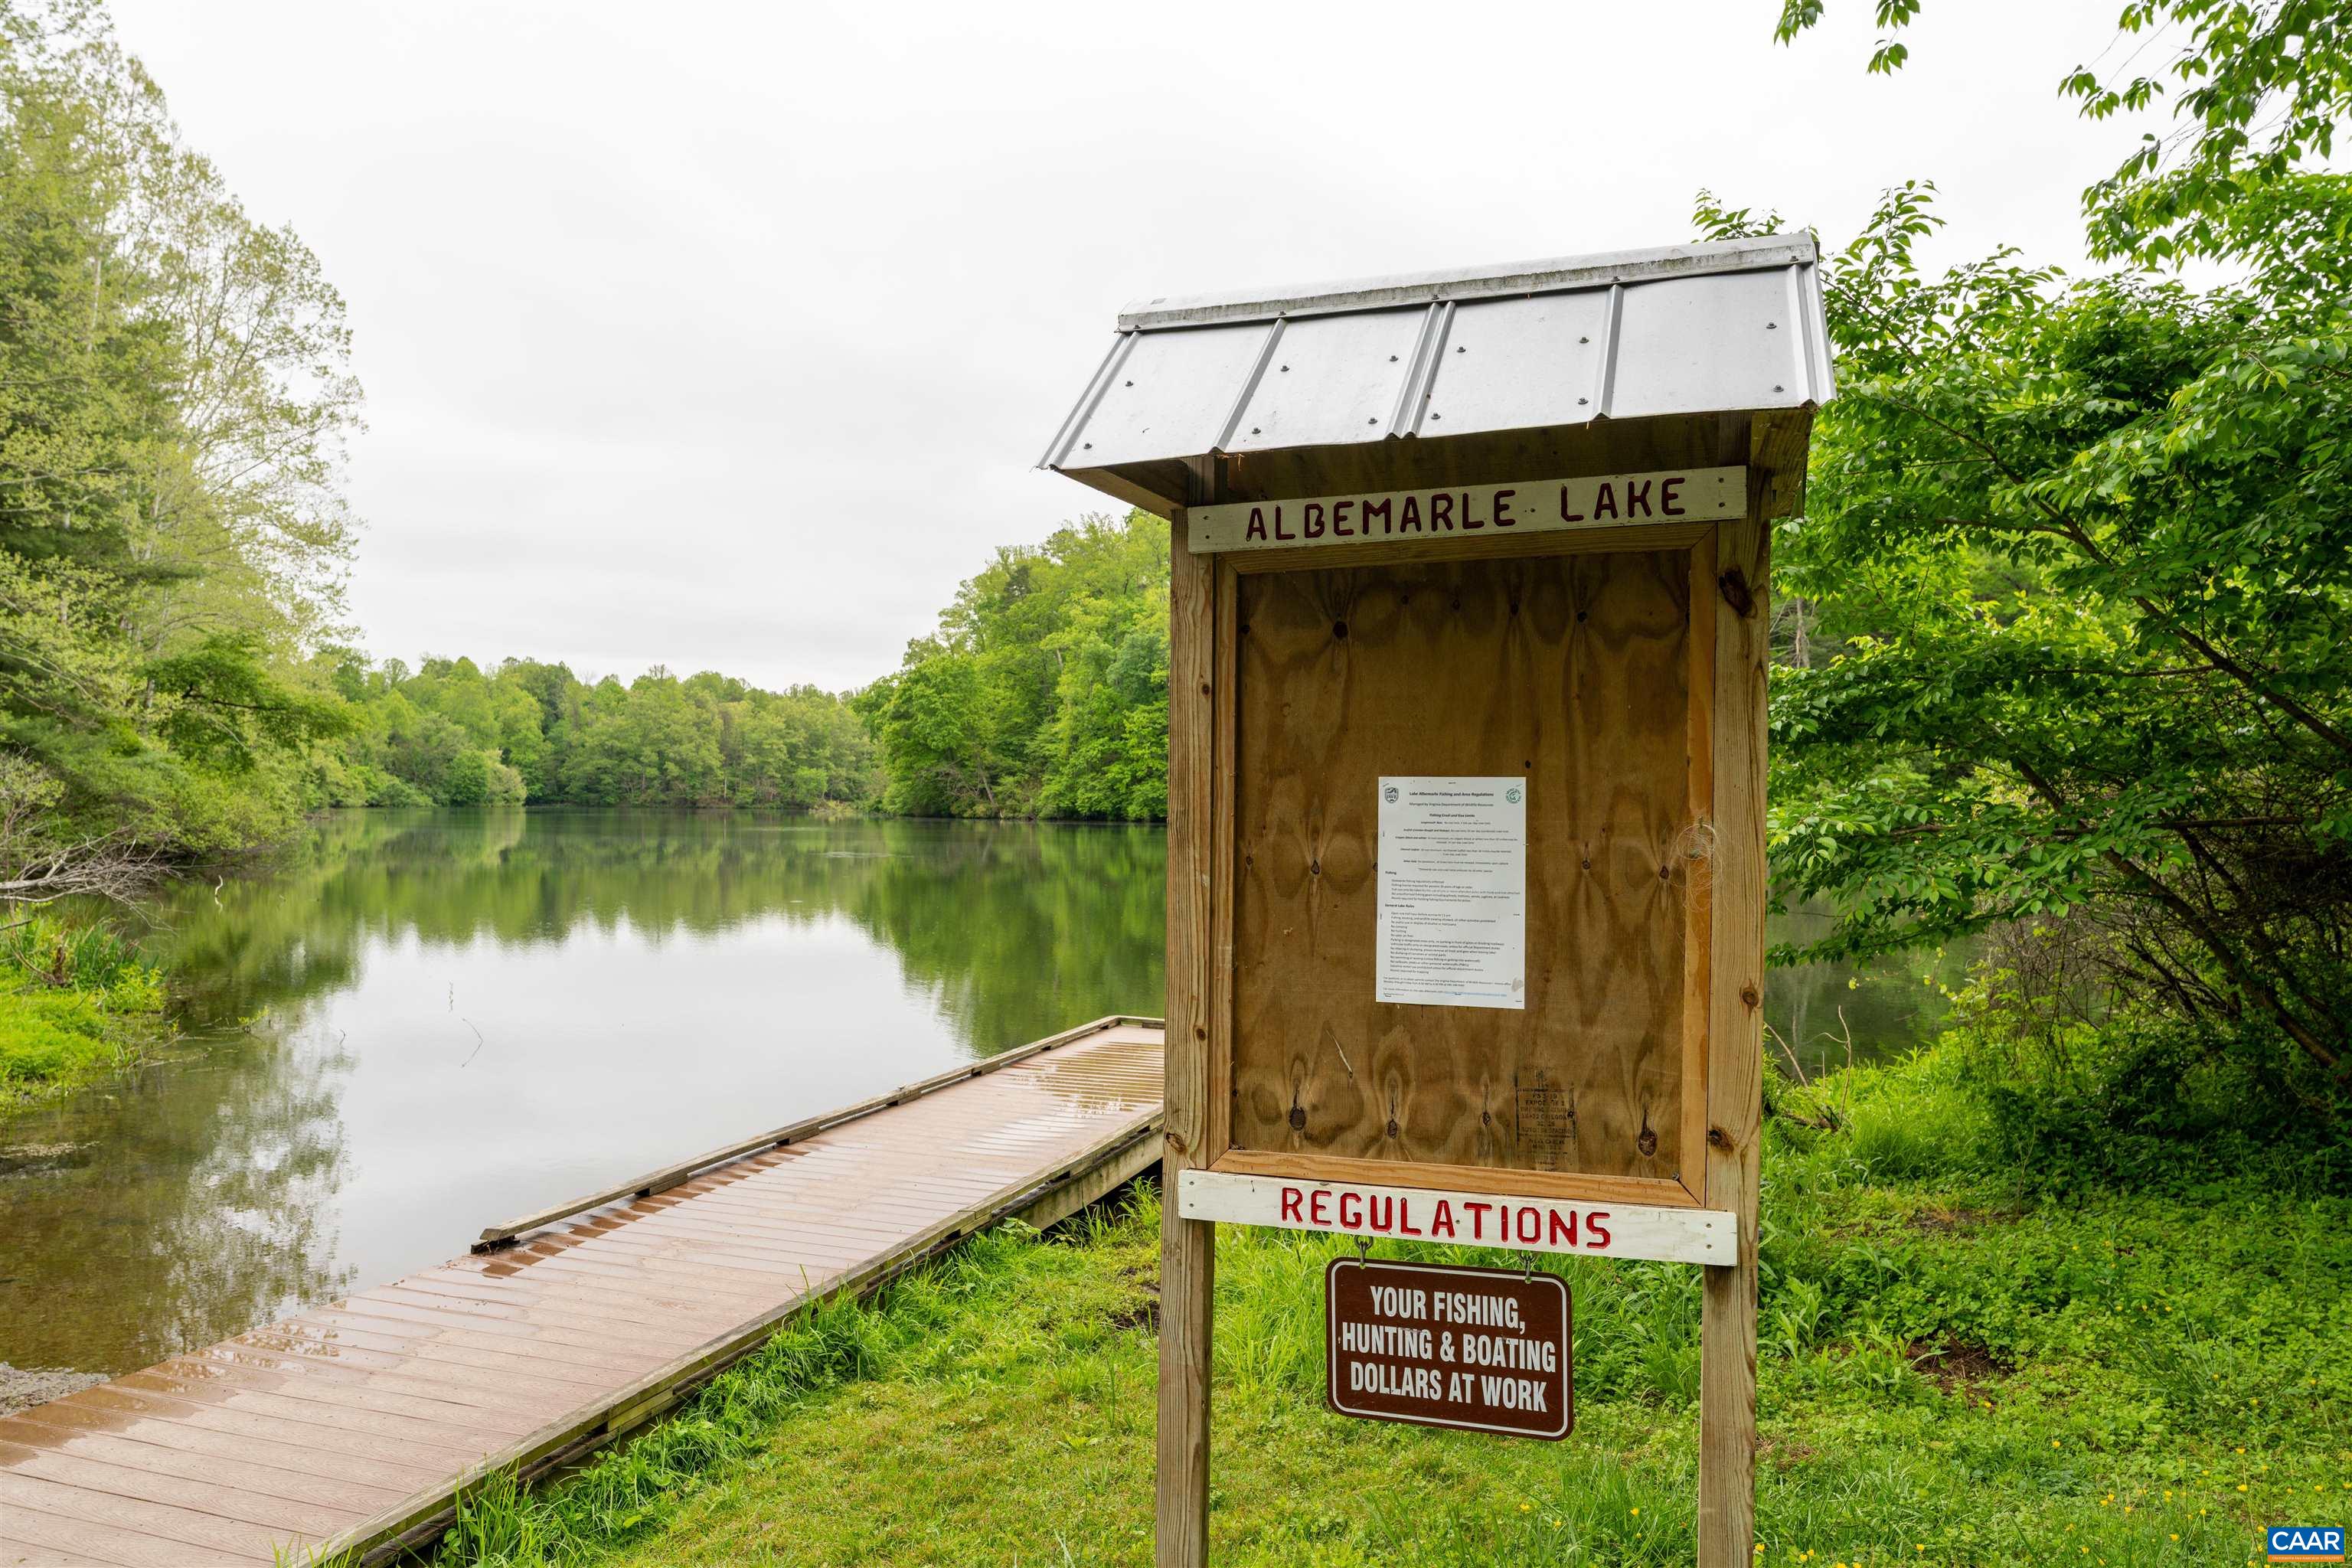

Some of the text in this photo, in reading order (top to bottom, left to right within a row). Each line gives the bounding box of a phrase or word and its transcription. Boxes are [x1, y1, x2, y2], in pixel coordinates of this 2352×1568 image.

[1246, 477, 1685, 541] ALBEMARLE LAKE
[1281, 1187, 1611, 1250] REGULATIONS
[1370, 1285, 1526, 1335] YOUR FISHING,
[1342, 1321, 1557, 1373] HUNTING & BOATING
[1351, 1361, 1548, 1413] DOLLARS AT WORK
